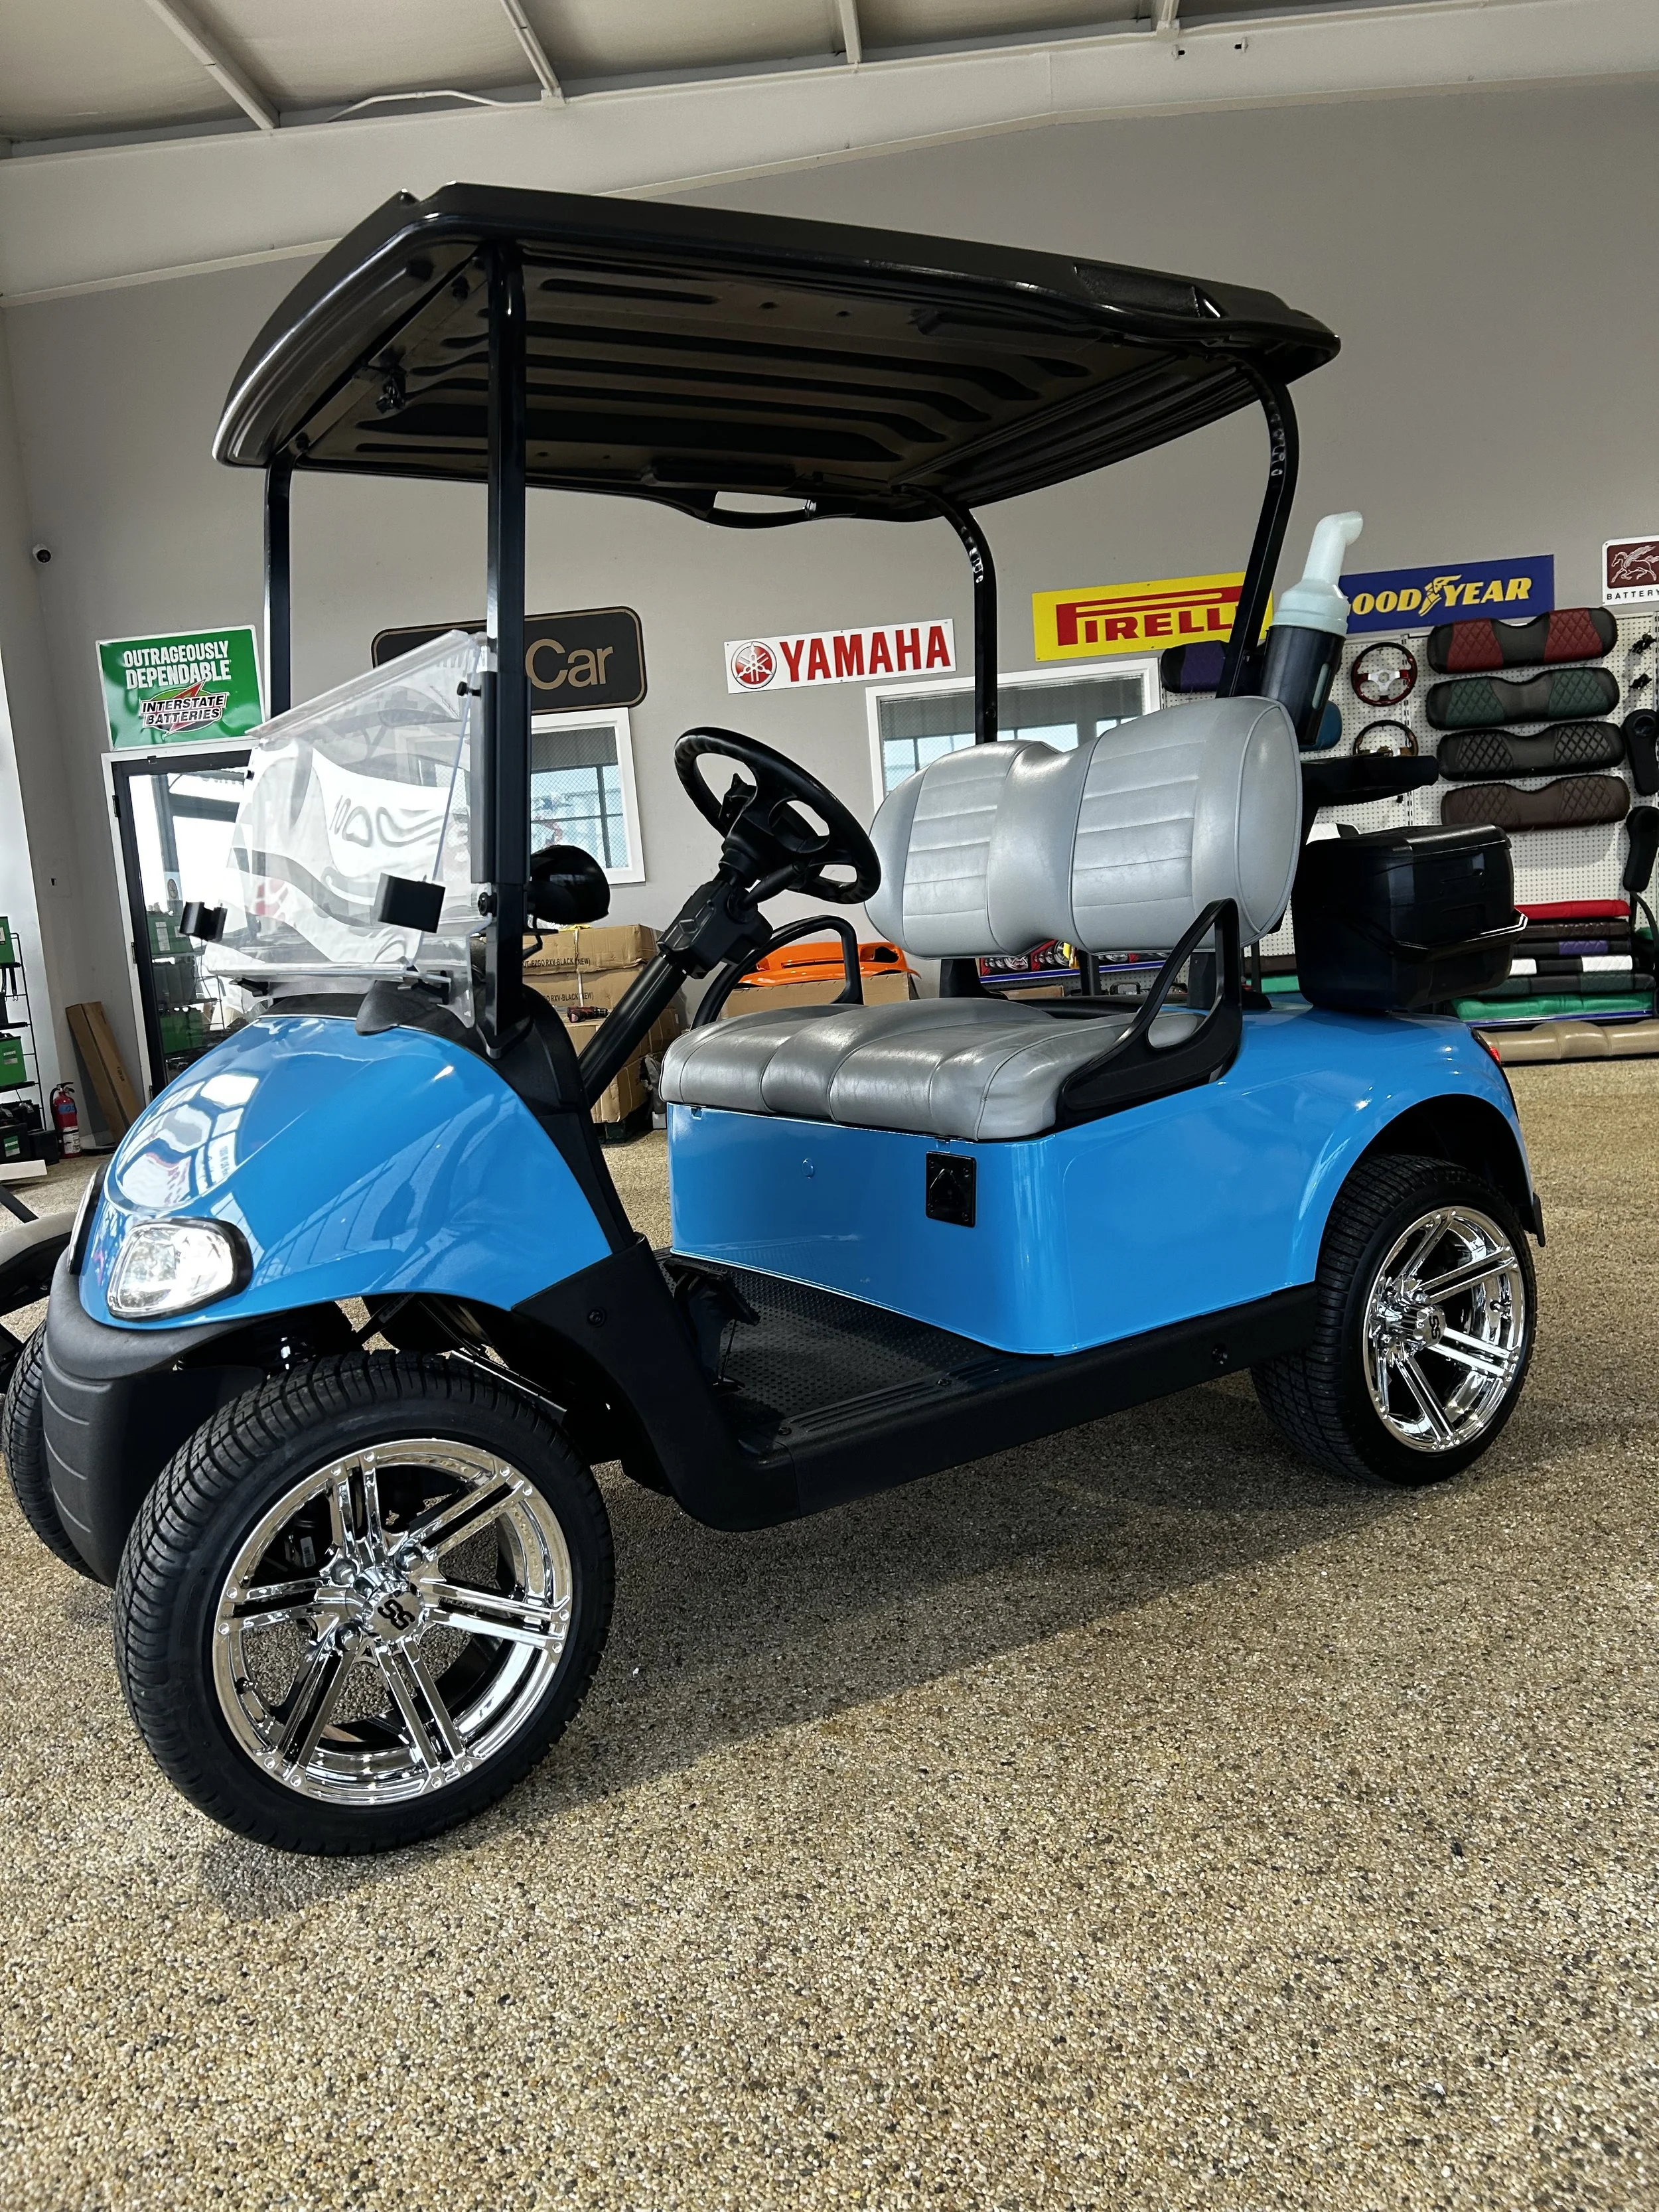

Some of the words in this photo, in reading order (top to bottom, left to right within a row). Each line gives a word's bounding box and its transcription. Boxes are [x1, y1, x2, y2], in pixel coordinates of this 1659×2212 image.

[1347, 577, 1533, 616] OODYEAR
[1056, 585, 1243, 646] PIRELL
[123, 640, 228, 668] OUTRAGEOUSLY
[525, 638, 614, 690] Car
[779, 625, 951, 683] YAMAHA
[125, 660, 232, 690] DEPENDABLE
[142, 696, 225, 713] INTERSTATE
[146, 708, 220, 725] BATTERIES
